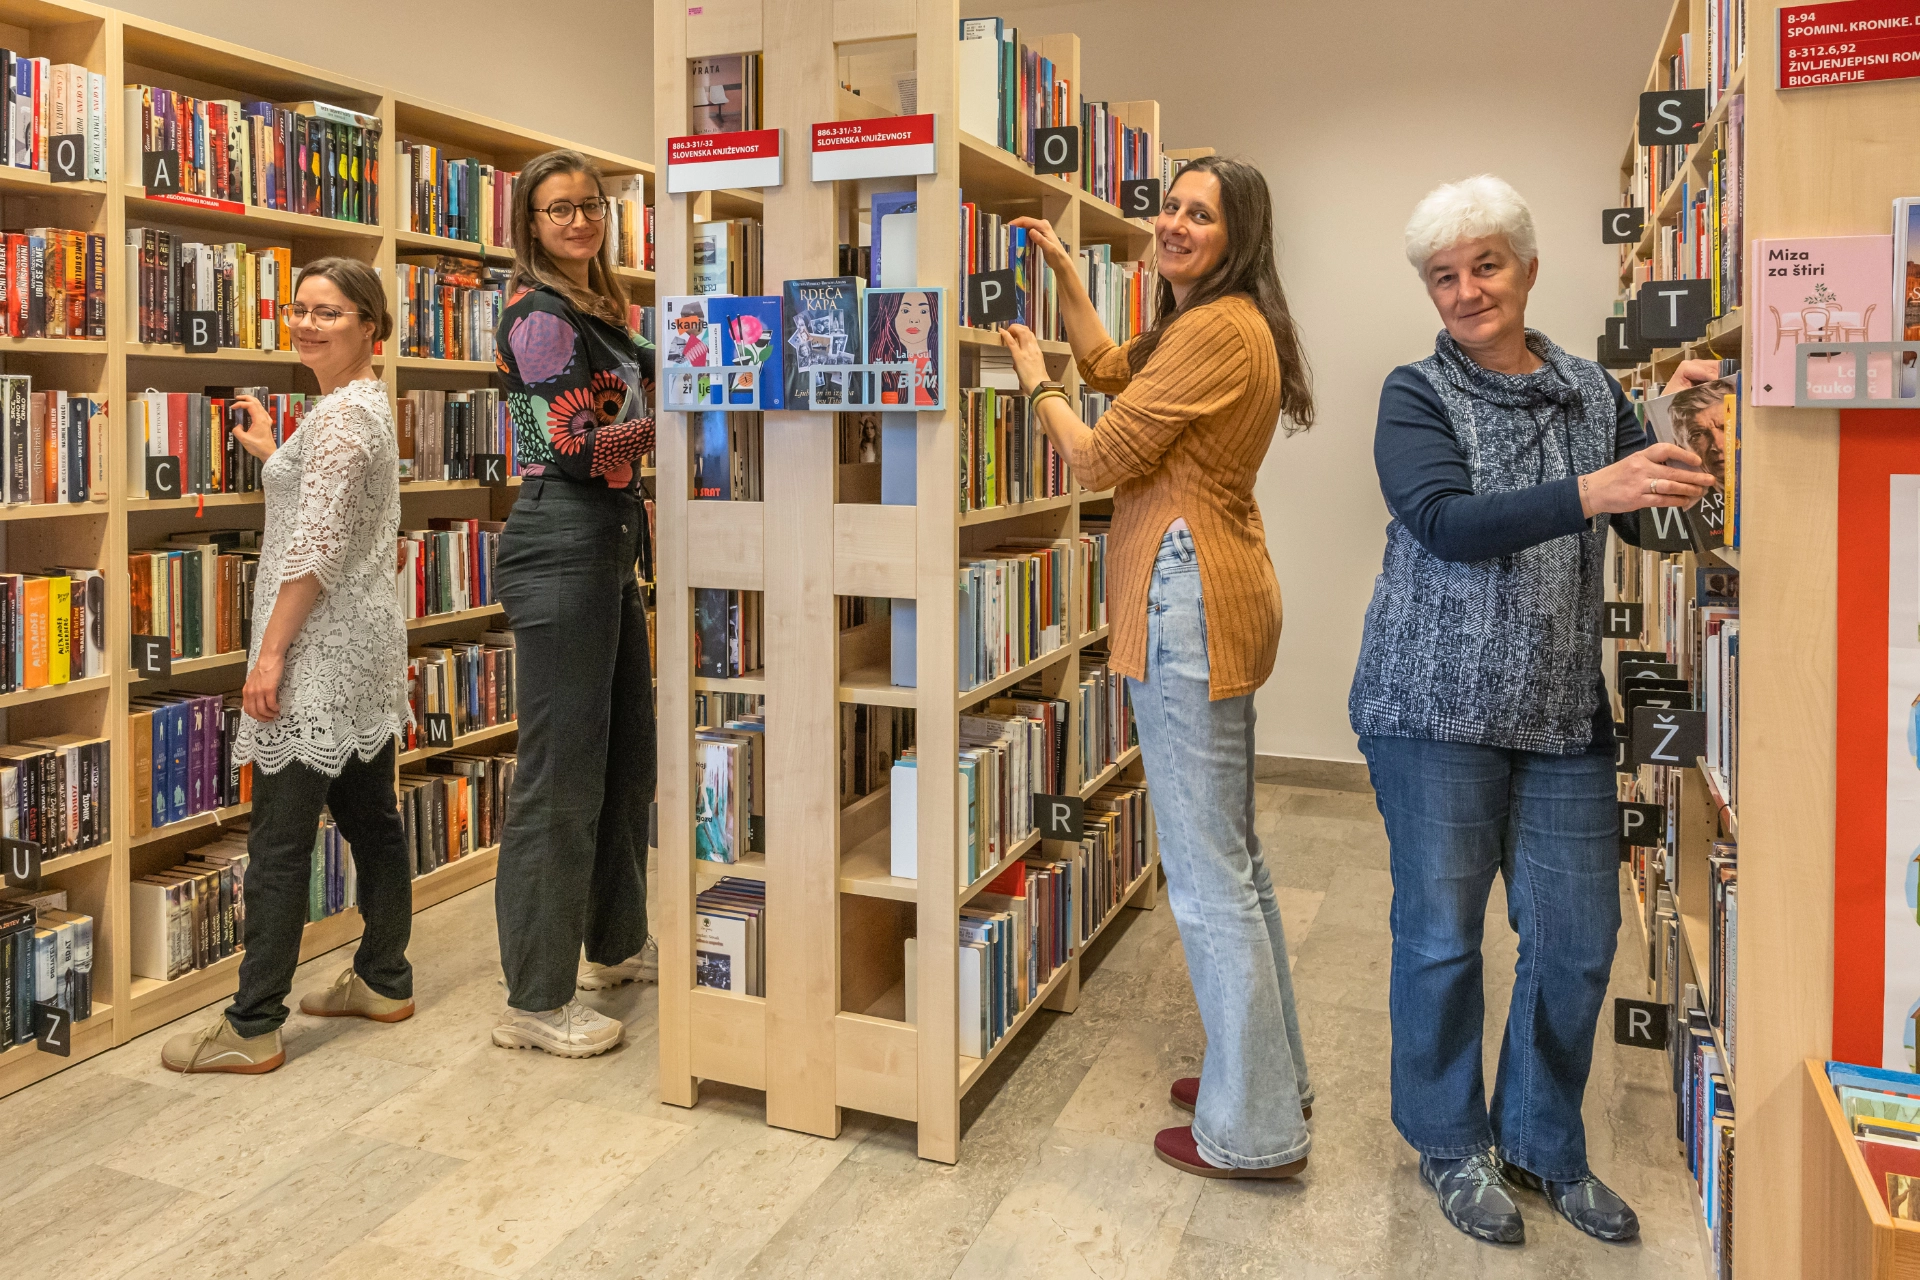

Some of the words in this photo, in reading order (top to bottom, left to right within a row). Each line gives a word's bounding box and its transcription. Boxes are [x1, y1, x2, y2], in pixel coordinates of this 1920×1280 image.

[1788, 12, 1816, 24] 8-94
[1788, 24, 1848, 38] SPOMINI.
[1850, 16, 1912, 32] KRONIKE.
[1788, 43, 1856, 59] 8-312.6,92
[1788, 53, 1889, 73] ŽIVLJENJEPISNI
[1789, 70, 1866, 86] BIOGRAFIJE
[1655, 99, 1682, 136] S
[817, 126, 862, 138] 886.3-31/-32
[817, 134, 860, 146] SLOVENSKA
[861, 130, 913, 144] KNJIŽEVNOST
[672, 139, 714, 150] 886.3-31/-32
[672, 148, 712, 160] SLOVENSKA
[712, 144, 760, 157] KNJIŽEVNOST
[1043, 134, 1068, 165] O
[57, 140, 76, 177] Q
[154, 158, 171, 188] A
[166, 194, 199, 204] ZGODOVINSKI
[200, 199, 220, 207] ROMANI
[1133, 185, 1150, 211] S
[1612, 213, 1632, 237] C
[36, 246, 44, 268] ZAME
[94, 237, 103, 260] JAMES
[1769, 248, 1810, 261] Miza
[20, 244, 28, 278] SPOMINI
[1768, 268, 1788, 277] za
[1792, 264, 1825, 276] štiri
[36, 270, 44, 280] SE
[94, 261, 103, 290] ROLLINS
[36, 280, 44, 298] UBIJ
[800, 286, 844, 301] RDEČA
[980, 280, 1002, 314] P
[806, 299, 838, 311] KAPA
[1658, 290, 1688, 327] T
[192, 317, 208, 346] B
[668, 318, 708, 332] Iskanje
[1838, 366, 1877, 378] Laa
[33, 426, 42, 474] Afrodiziak
[156, 462, 172, 492] C
[486, 460, 500, 482] K
[700, 488, 721, 497] SRAT
[1610, 608, 1630, 633] H
[30, 612, 41, 668] ALEXANDER
[57, 616, 65, 655] ALEXANDER
[147, 642, 160, 672] E
[430, 718, 448, 742] M
[1650, 713, 1680, 762] Ž
[82, 794, 90, 822] ŽUPNIK
[1052, 802, 1072, 834] R
[30, 807, 38, 840] ČEŠNJE
[1623, 809, 1645, 837] P
[12, 847, 30, 880] U
[46, 1013, 61, 1046] Z
[1628, 1007, 1652, 1041] R
